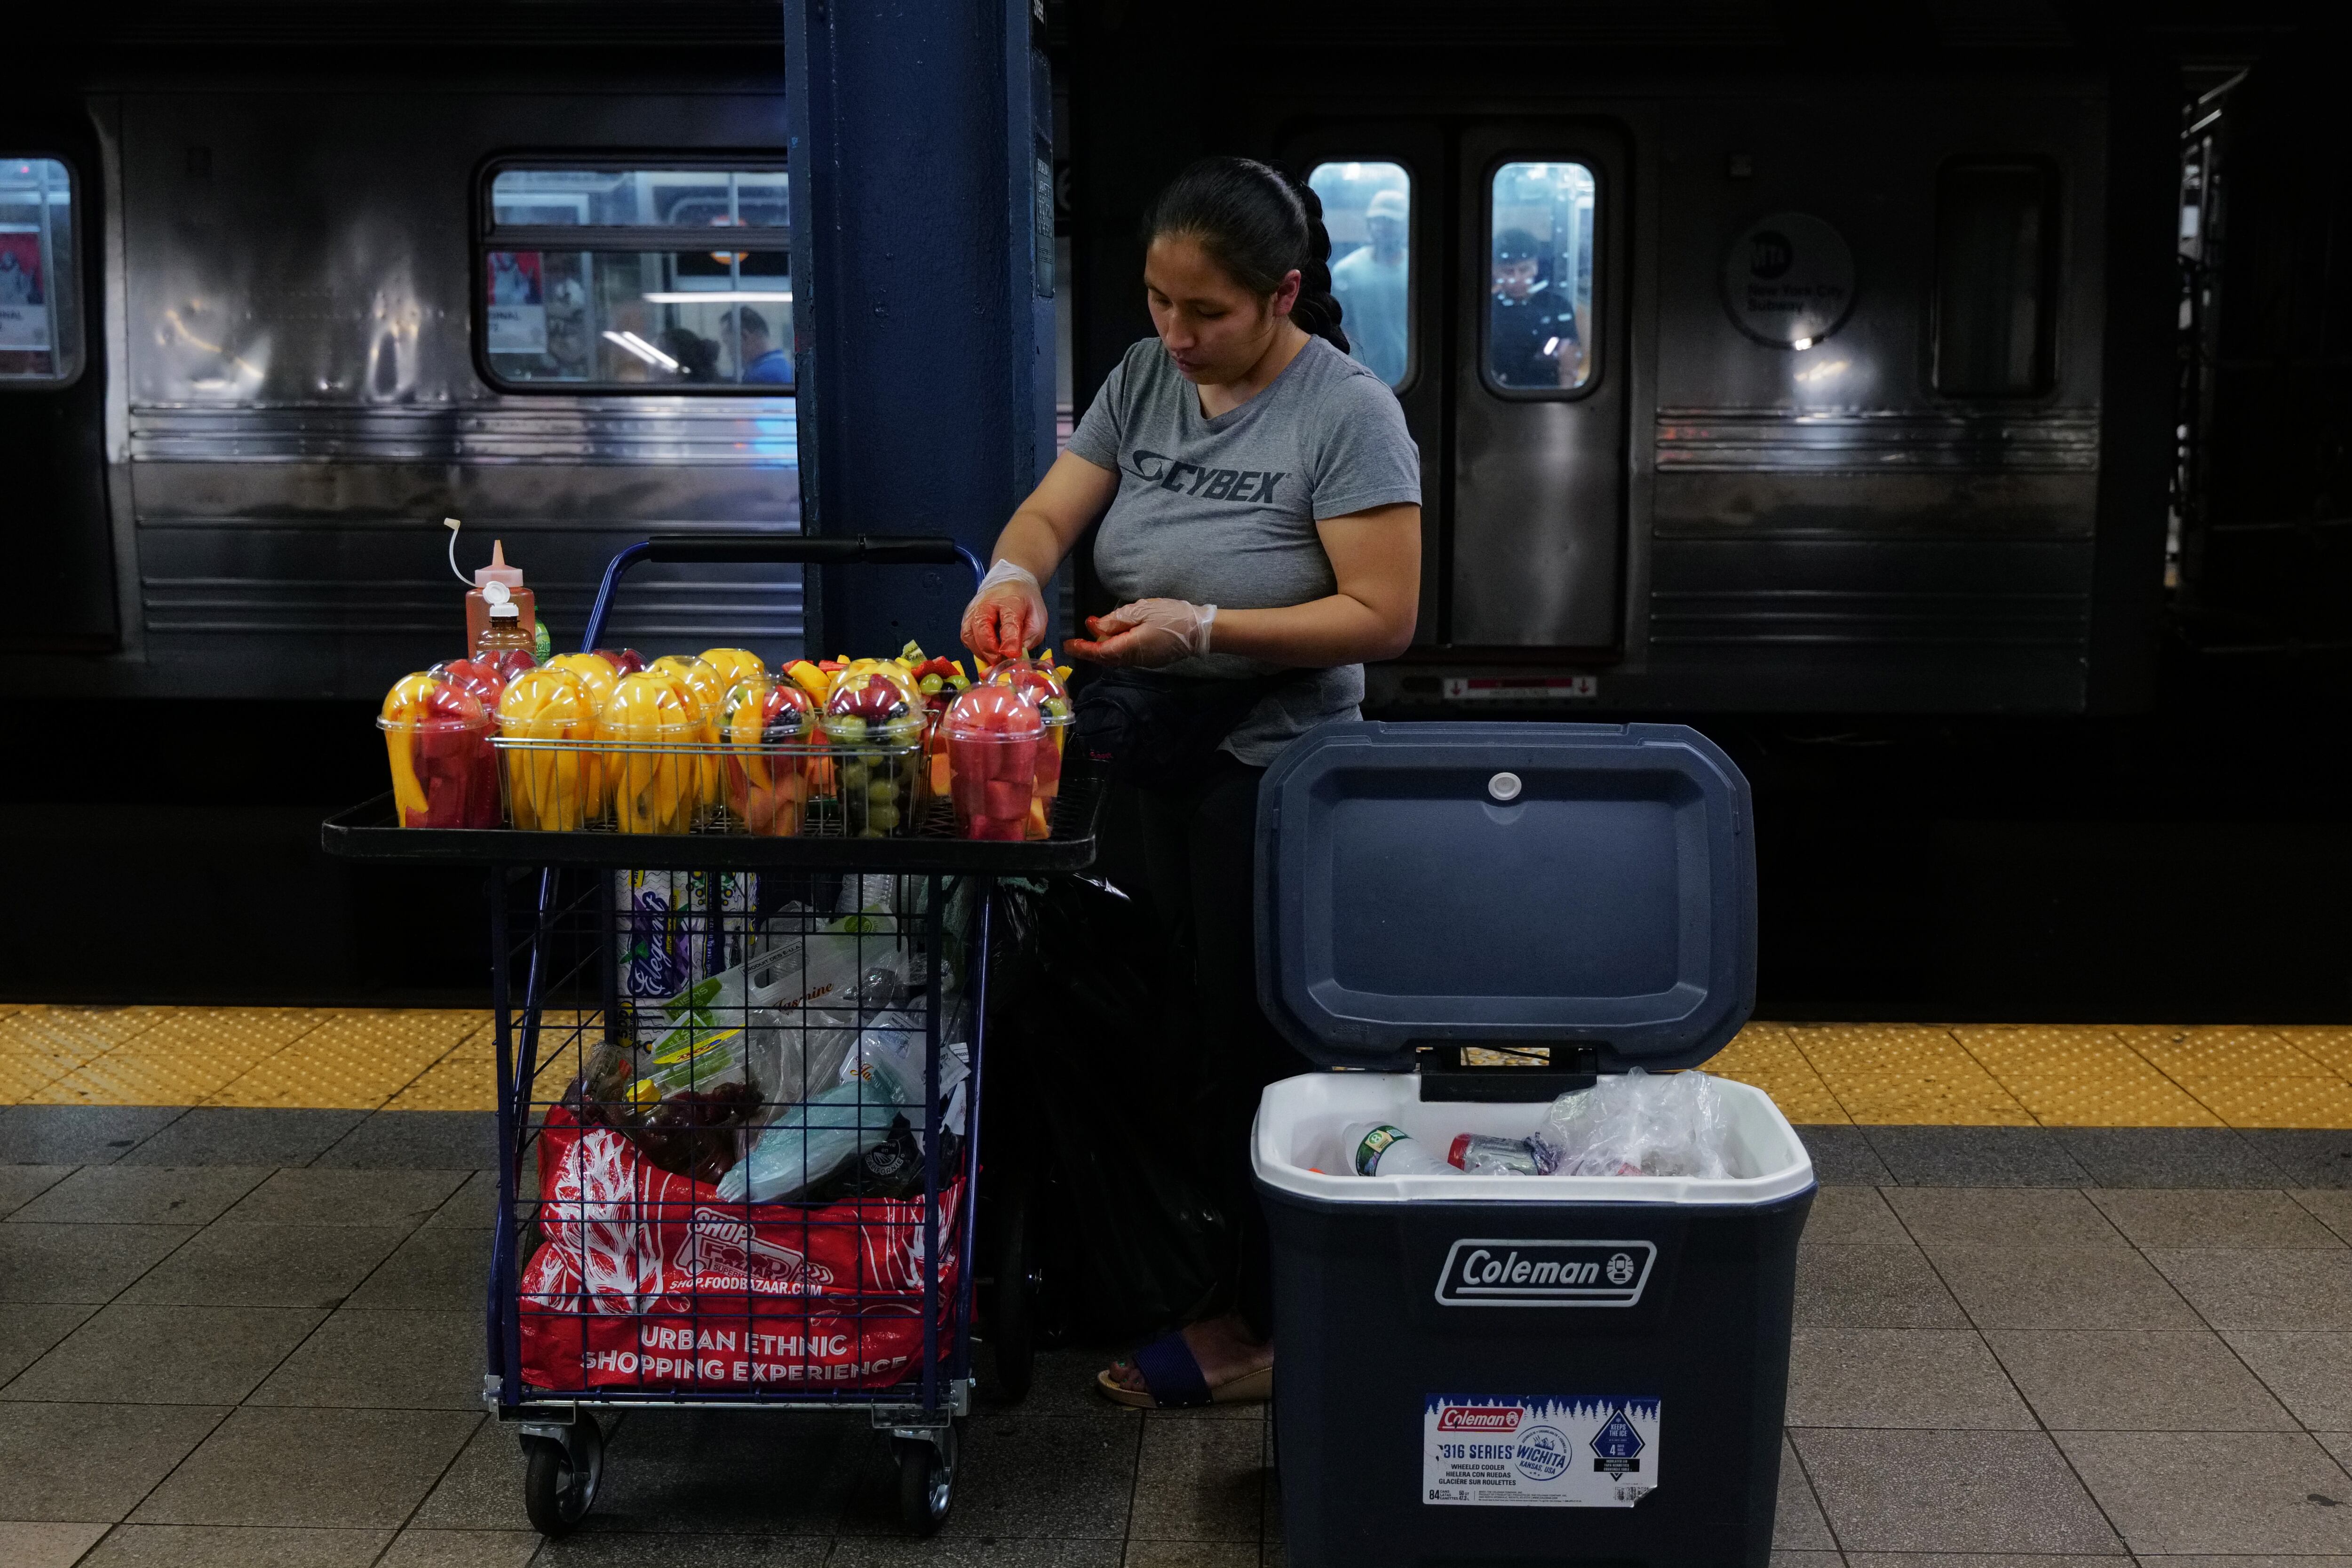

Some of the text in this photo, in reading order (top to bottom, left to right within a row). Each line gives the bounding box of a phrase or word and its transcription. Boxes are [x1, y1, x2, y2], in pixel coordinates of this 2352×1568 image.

[1161, 461, 1285, 503] CYBEX
[694, 1212, 749, 1244] SHOP
[1462, 1250, 1600, 1285] Coleman
[670, 1276, 823, 1296] SHOP.FOODBAZAAR.COM
[641, 1324, 847, 1357] URBAN ETHNIC
[580, 1350, 907, 1382] SHOPPING EXPERIENCE
[1444, 1409, 1505, 1426] Coleman
[1444, 1444, 1512, 1459] 316 SERIES
[1517, 1444, 1566, 1468] WICHITA
[1610, 1444, 1616, 1456] 4
[1519, 1460, 1556, 1474] KANSAS, USA
[1429, 1489, 1439, 1500] 84
